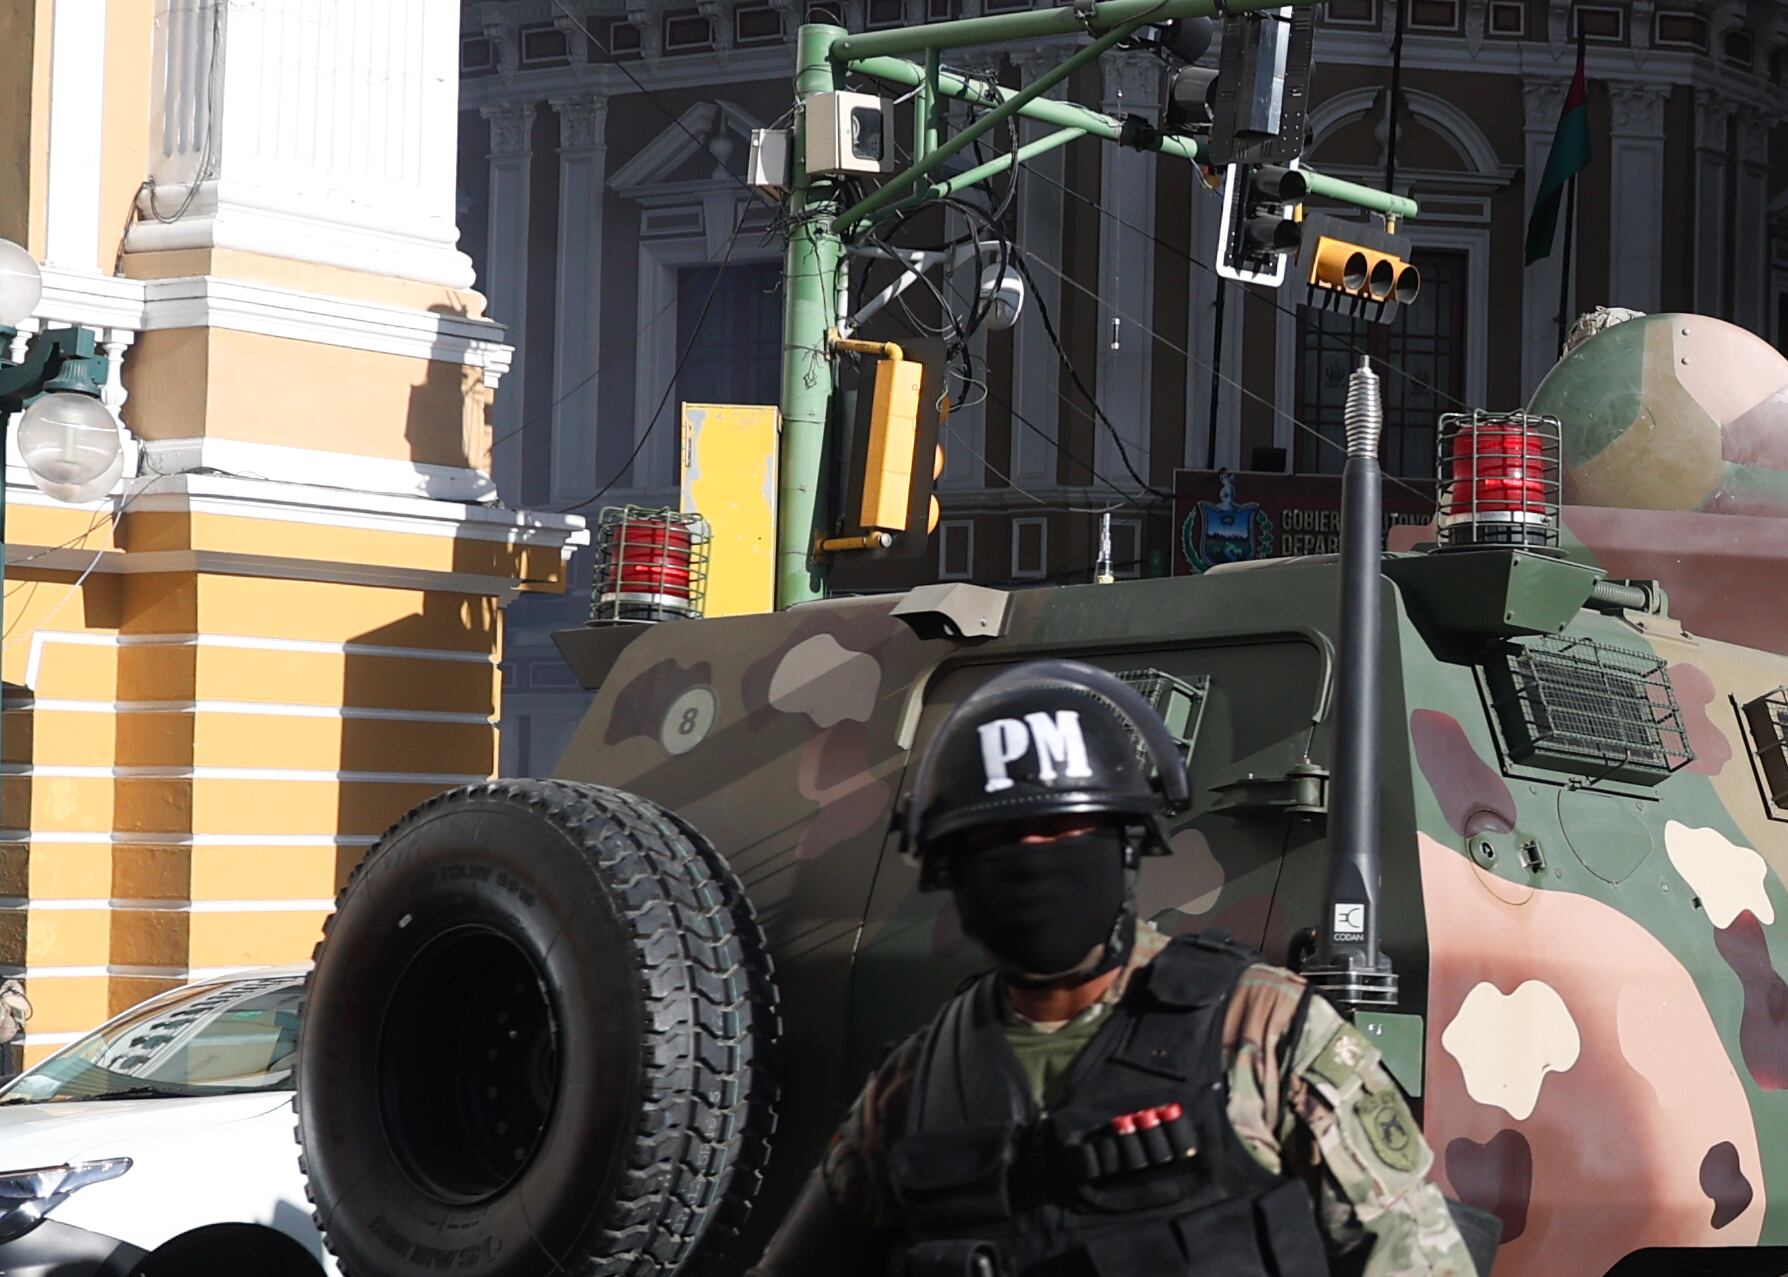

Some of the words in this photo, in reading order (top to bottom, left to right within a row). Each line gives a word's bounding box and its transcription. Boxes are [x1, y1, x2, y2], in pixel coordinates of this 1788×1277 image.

[1281, 509, 1340, 531] GOBIER
[1281, 534, 1339, 556] DEPAR
[679, 707, 698, 735] 8
[977, 710, 1093, 792] PM
